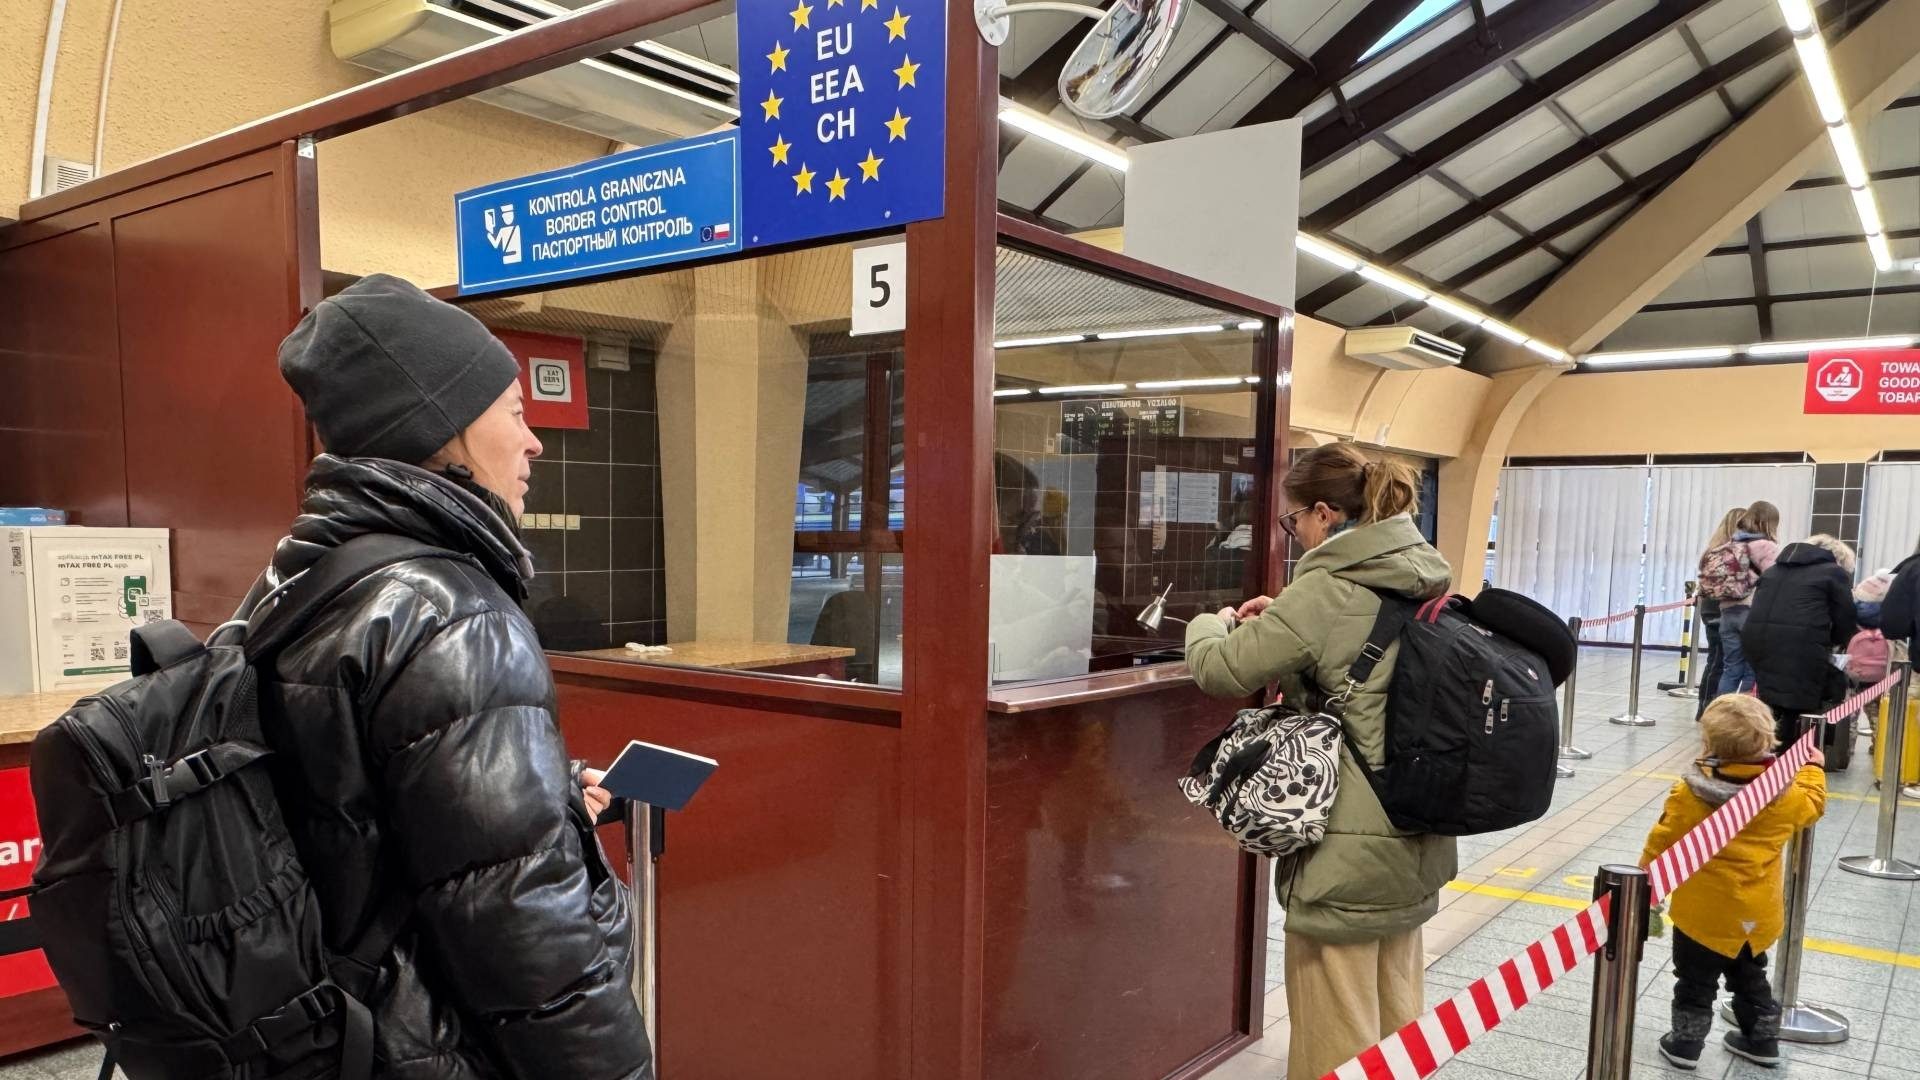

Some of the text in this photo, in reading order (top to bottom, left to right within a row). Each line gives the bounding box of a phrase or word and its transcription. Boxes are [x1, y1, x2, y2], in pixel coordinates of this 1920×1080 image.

[817, 22, 853, 61] EU
[810, 64, 864, 104] EEA
[816, 107, 855, 143] CH
[529, 166, 686, 217] KONTROLA GRANICZNA
[546, 196, 666, 236] BORDER CONTROL
[532, 216, 693, 262] ПАСПОРТНЫЙ КОНТРОЛЬ
[869, 263, 891, 308] 5
